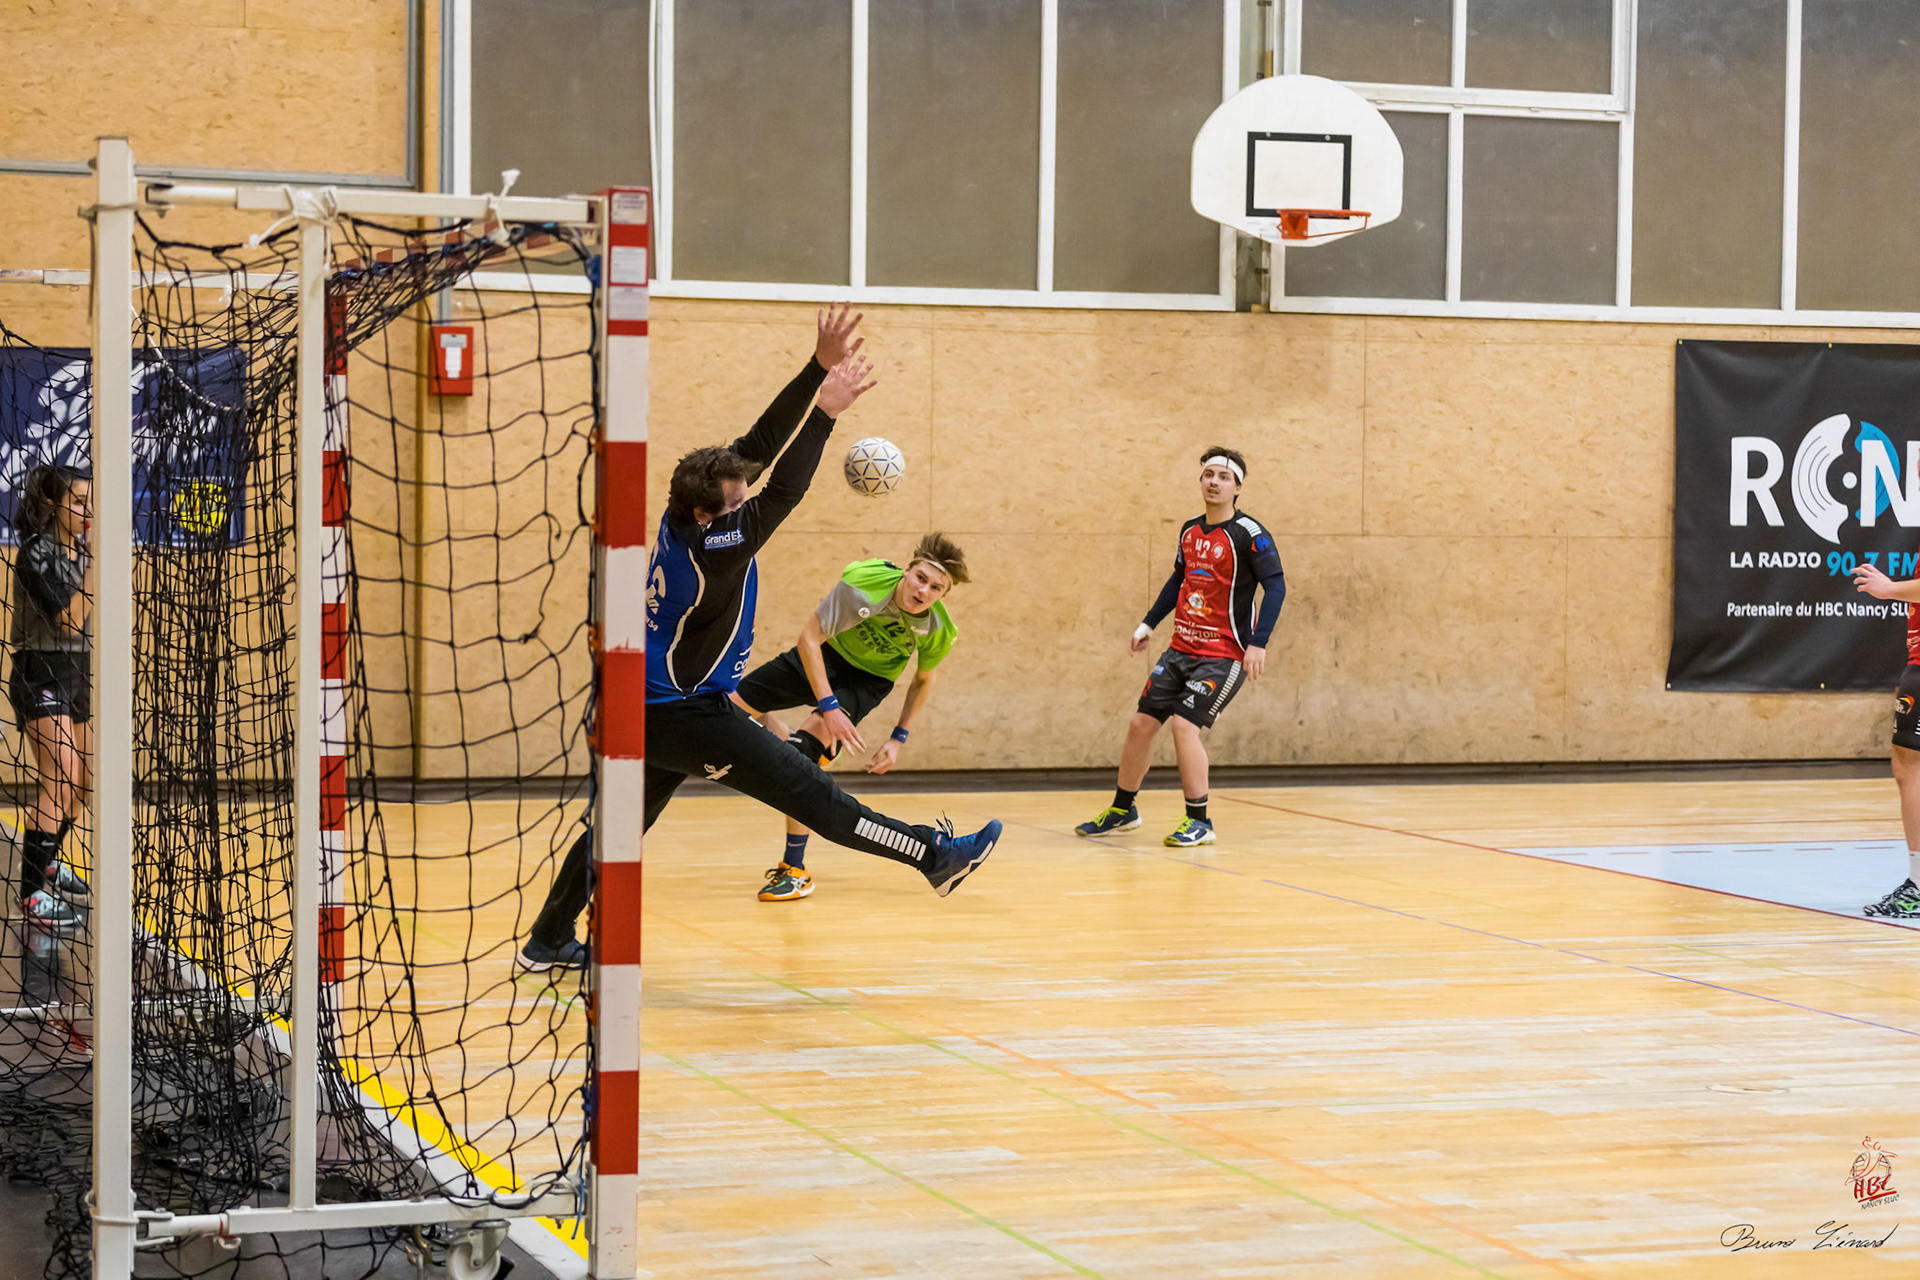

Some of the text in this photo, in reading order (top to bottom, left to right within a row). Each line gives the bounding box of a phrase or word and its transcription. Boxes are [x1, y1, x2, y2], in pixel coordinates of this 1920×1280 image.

[705, 532, 730, 545] Grand
[1730, 551, 1919, 576] LA RADIO 907 FM
[1727, 602, 1793, 617] Partenaire
[1795, 601, 1812, 616] du
[1815, 602, 1843, 617] HBC
[1846, 602, 1888, 620] Nancy
